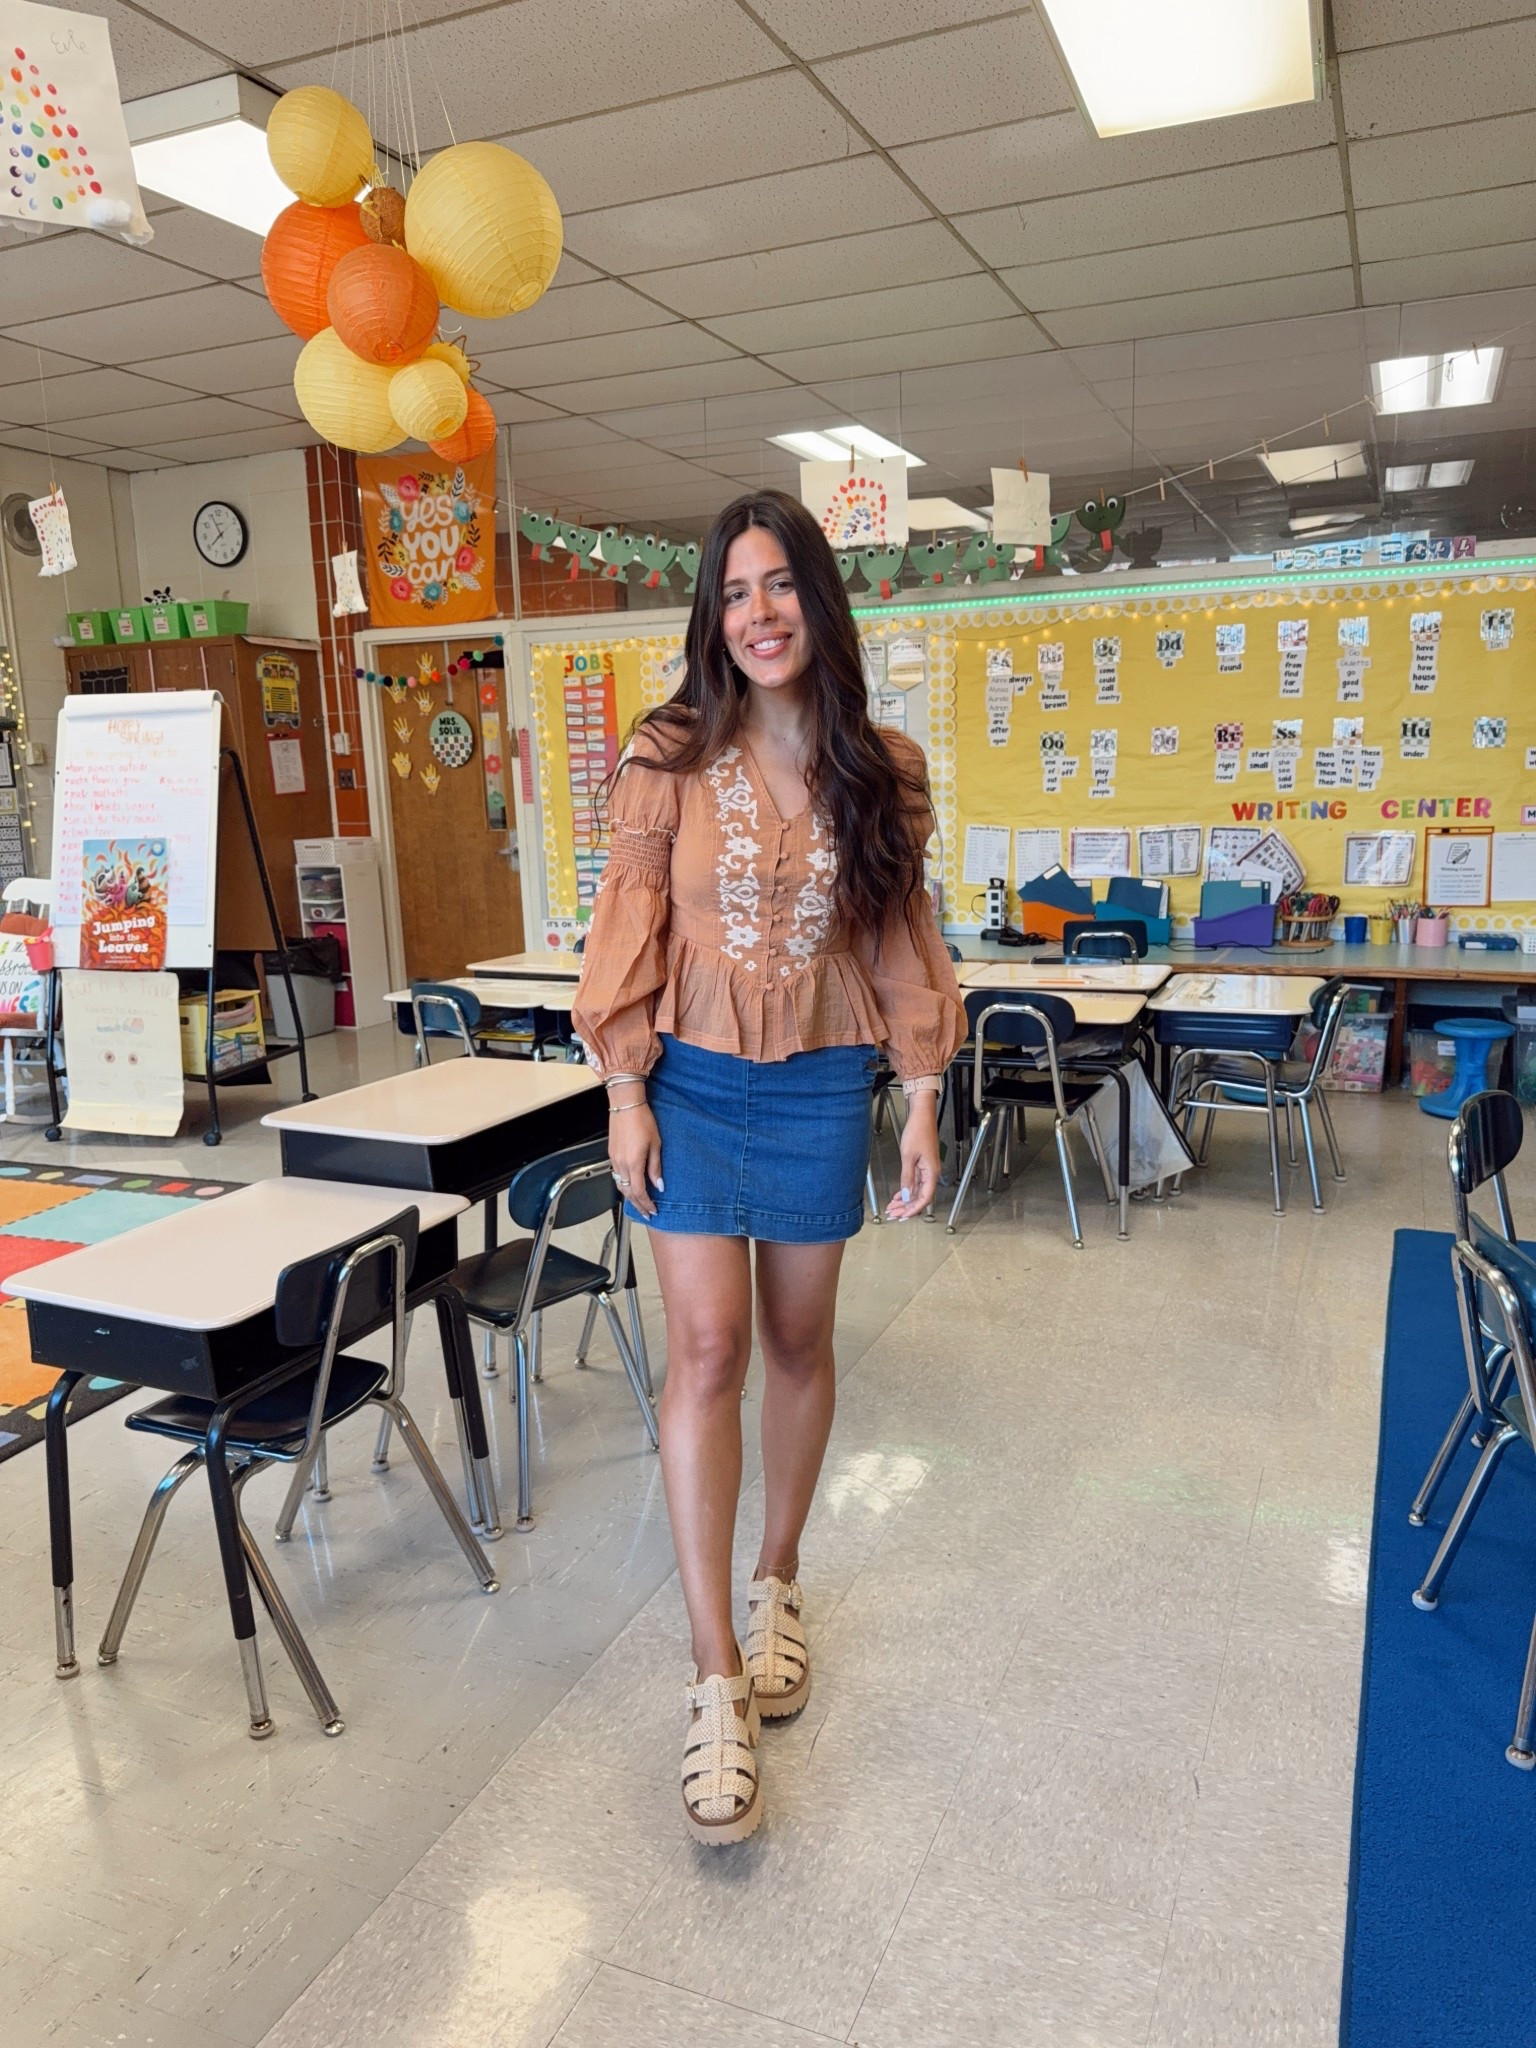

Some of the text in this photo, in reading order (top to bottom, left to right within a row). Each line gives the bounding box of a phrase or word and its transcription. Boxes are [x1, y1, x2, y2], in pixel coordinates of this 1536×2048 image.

[400, 495, 454, 532] yes
[402, 525, 460, 560] YOU
[407, 557, 461, 584] can
[1157, 637, 1182, 651] Dd
[564, 653, 614, 673] JOBS
[1219, 664, 1242, 672] found
[1009, 676, 1032, 685] always
[1412, 673, 1436, 681] house
[1047, 683, 1055, 691] by
[1342, 679, 1359, 688] good
[1415, 683, 1429, 691] her
[1098, 694, 1120, 702] country
[1343, 691, 1359, 701] give
[1044, 701, 1067, 709] brown
[439, 717, 458, 725] MRS.
[439, 727, 461, 735] SOLIK
[1276, 728, 1296, 739] Ss
[1217, 730, 1240, 742] Rr
[1042, 737, 1064, 750] Oo
[1218, 762, 1235, 771] right
[1095, 768, 1109, 777] play
[1362, 769, 1375, 778] try
[1097, 778, 1108, 786] put
[1381, 797, 1493, 819] CENTER
[92, 915, 156, 936] Jumping
[109, 933, 141, 941] into the
[98, 939, 149, 953] Leaves
[139, 977, 173, 998] Talk
